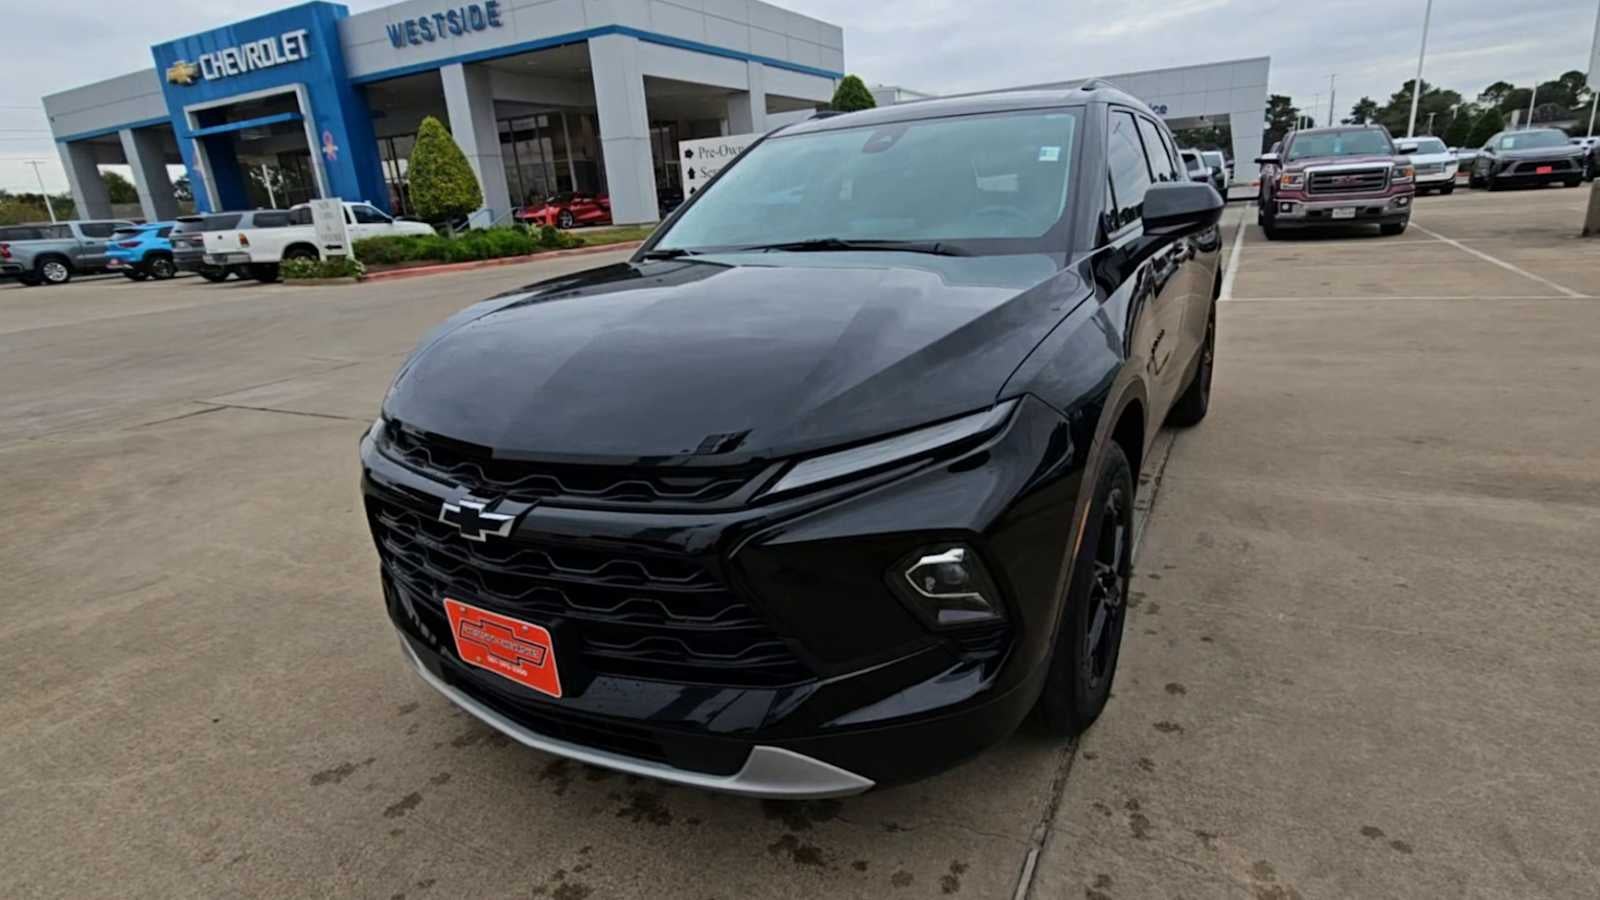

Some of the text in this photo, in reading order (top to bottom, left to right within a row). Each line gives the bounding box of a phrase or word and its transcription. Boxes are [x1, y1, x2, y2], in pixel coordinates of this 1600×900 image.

[386, 0, 503, 48] WESTSIDE
[200, 29, 309, 81] CHEVROLET
[698, 144, 744, 159] Pre-Own
